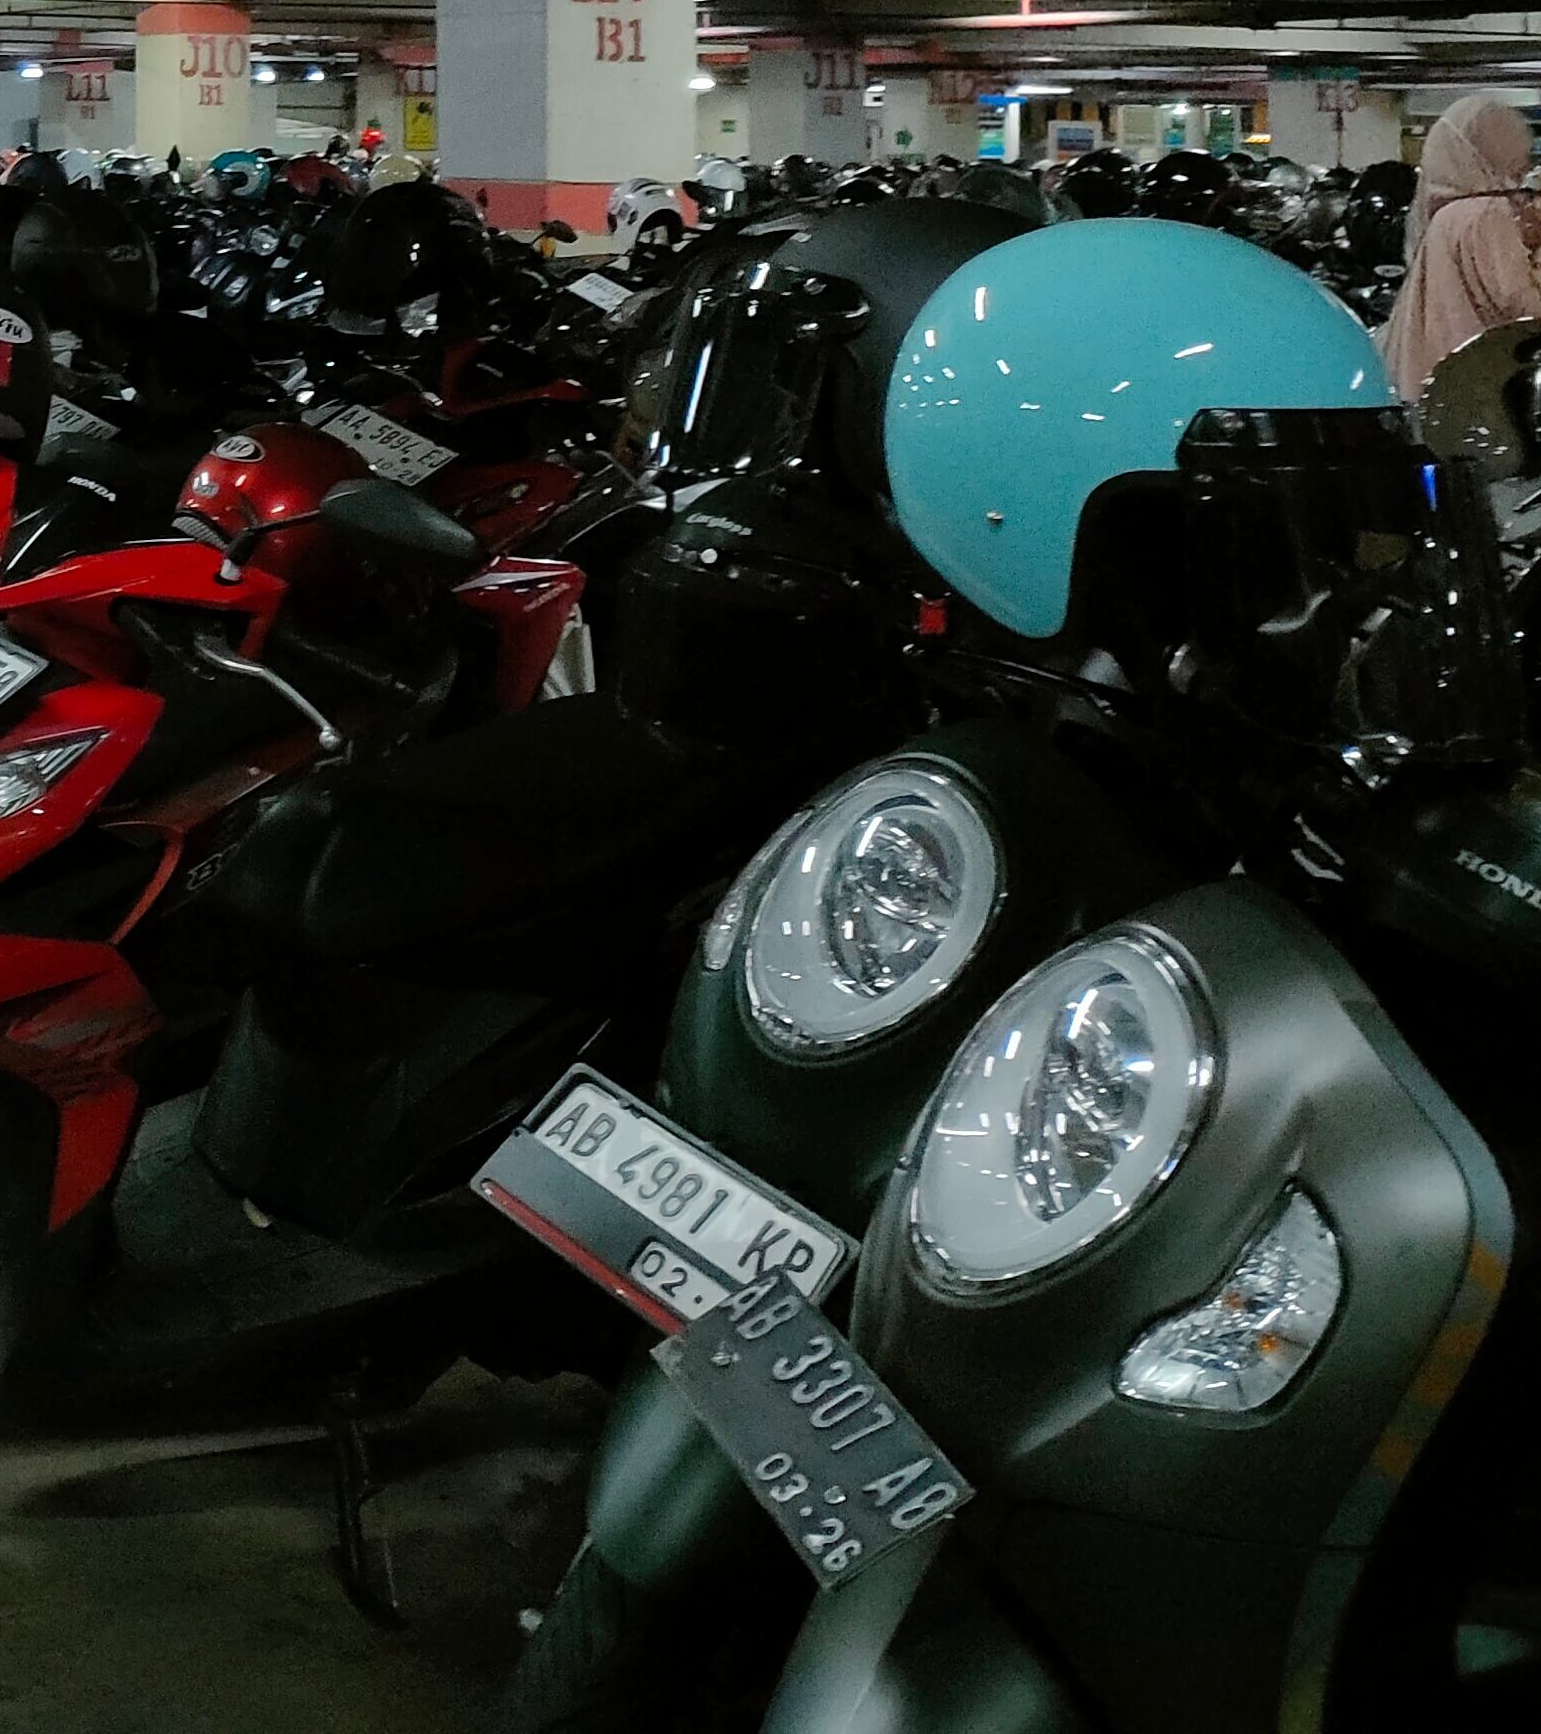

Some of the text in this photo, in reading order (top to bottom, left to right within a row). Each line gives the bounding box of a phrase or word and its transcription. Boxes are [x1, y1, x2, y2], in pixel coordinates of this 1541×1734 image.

[179, 35, 248, 79] J10
[595, 17, 648, 63] B1
[198, 84, 224, 107] B1
[338, 409, 371, 433] AA
[545, 1102, 616, 1157] AB
[614, 1145, 729, 1235] 4981
[717, 1276, 802, 1341] AB
[772, 1335, 897, 1452] 3307
